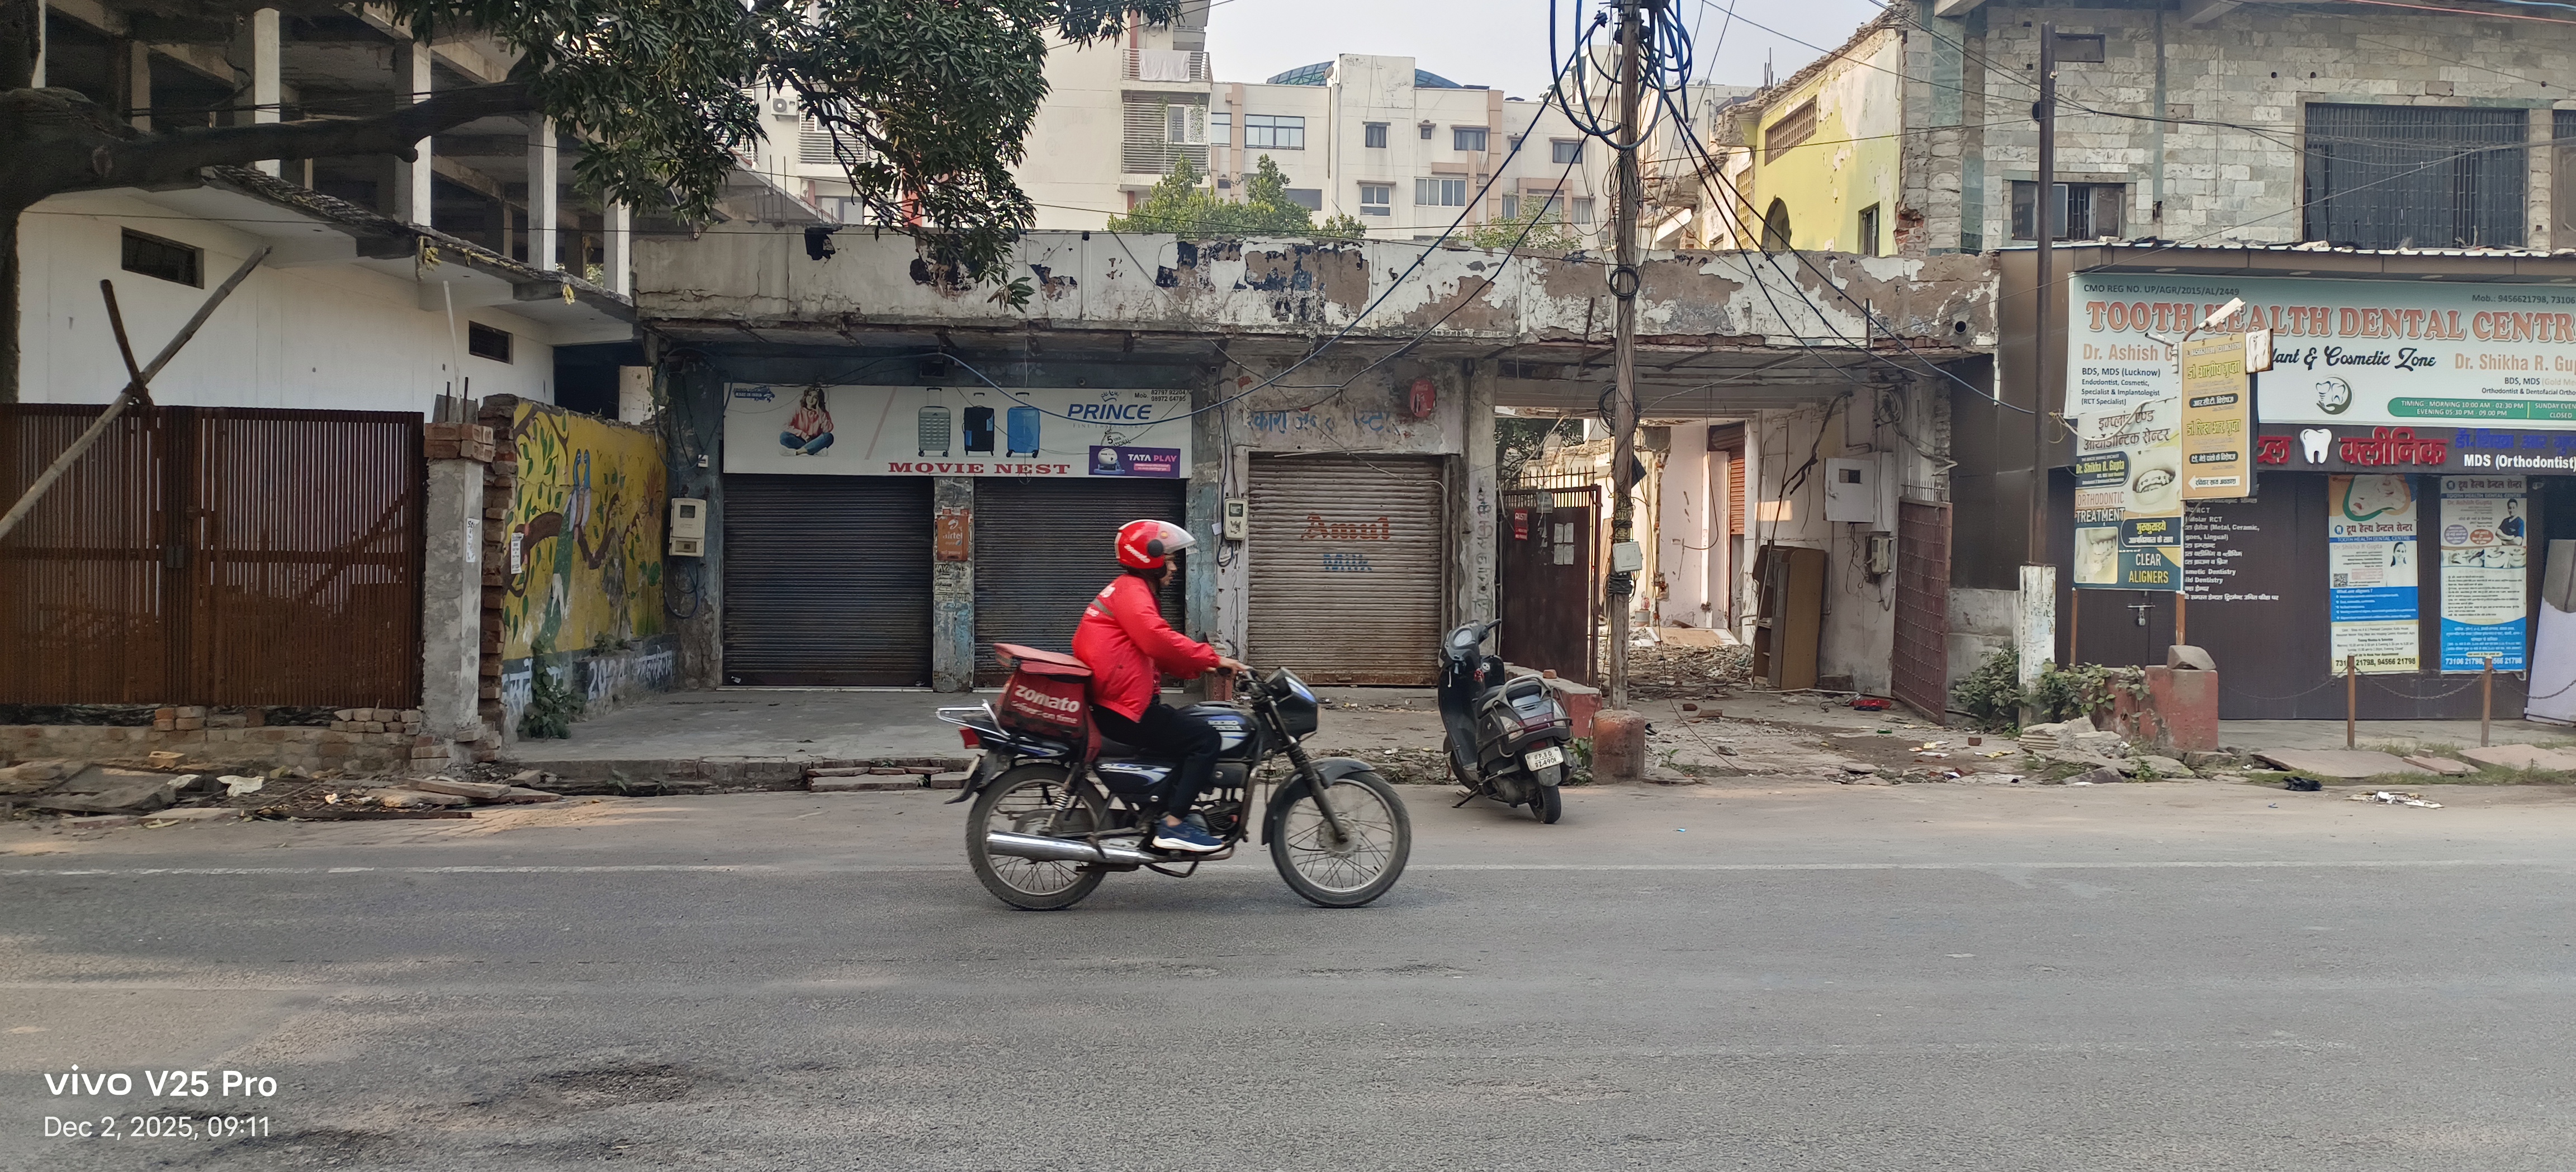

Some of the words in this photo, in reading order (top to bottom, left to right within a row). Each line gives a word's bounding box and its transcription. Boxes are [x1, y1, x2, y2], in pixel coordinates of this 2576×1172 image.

[2083, 284, 2105, 292] CMO
[2107, 285, 2124, 293] REG
[2144, 286, 2239, 295] UP/AGR/2015/AL/2449
[2498, 295, 2549, 304] 9456621798,
[2551, 296, 2576, 304] 73106
[2086, 301, 2196, 332] TOOTH
[2338, 308, 2466, 341] DENTAL
[2473, 311, 2576, 343] CENTR
[2083, 343, 2103, 360] Dr.
[2109, 344, 2158, 361] Ashish
[2304, 347, 2318, 370] &
[2324, 346, 2390, 366] Cosmetic
[2394, 348, 2436, 372] Zone
[2455, 353, 2473, 370] Dr.
[2479, 353, 2528, 371] Shikha
[2535, 355, 2548, 371] R.
[2082, 368, 2100, 376] BDS,
[2122, 368, 2161, 377] (Lucknow)
[2504, 377, 2521, 386] BDS,
[1067, 404, 1153, 419] PRINCE
[2338, 426, 2449, 465] क्लीनिक
[888, 462, 984, 474] MOVIE
[994, 464, 1071, 474] NEST
[2464, 453, 2492, 467] MDS
[2495, 453, 2576, 474] (Orthodontist)
[2077, 491, 2124, 507] ORTHODONTIC
[2076, 507, 2125, 523] TREATMENT
[2135, 553, 2161, 566] CLEAR
[2128, 570, 2169, 584] ALIGNERS
[1014, 684, 1081, 713] zomato
